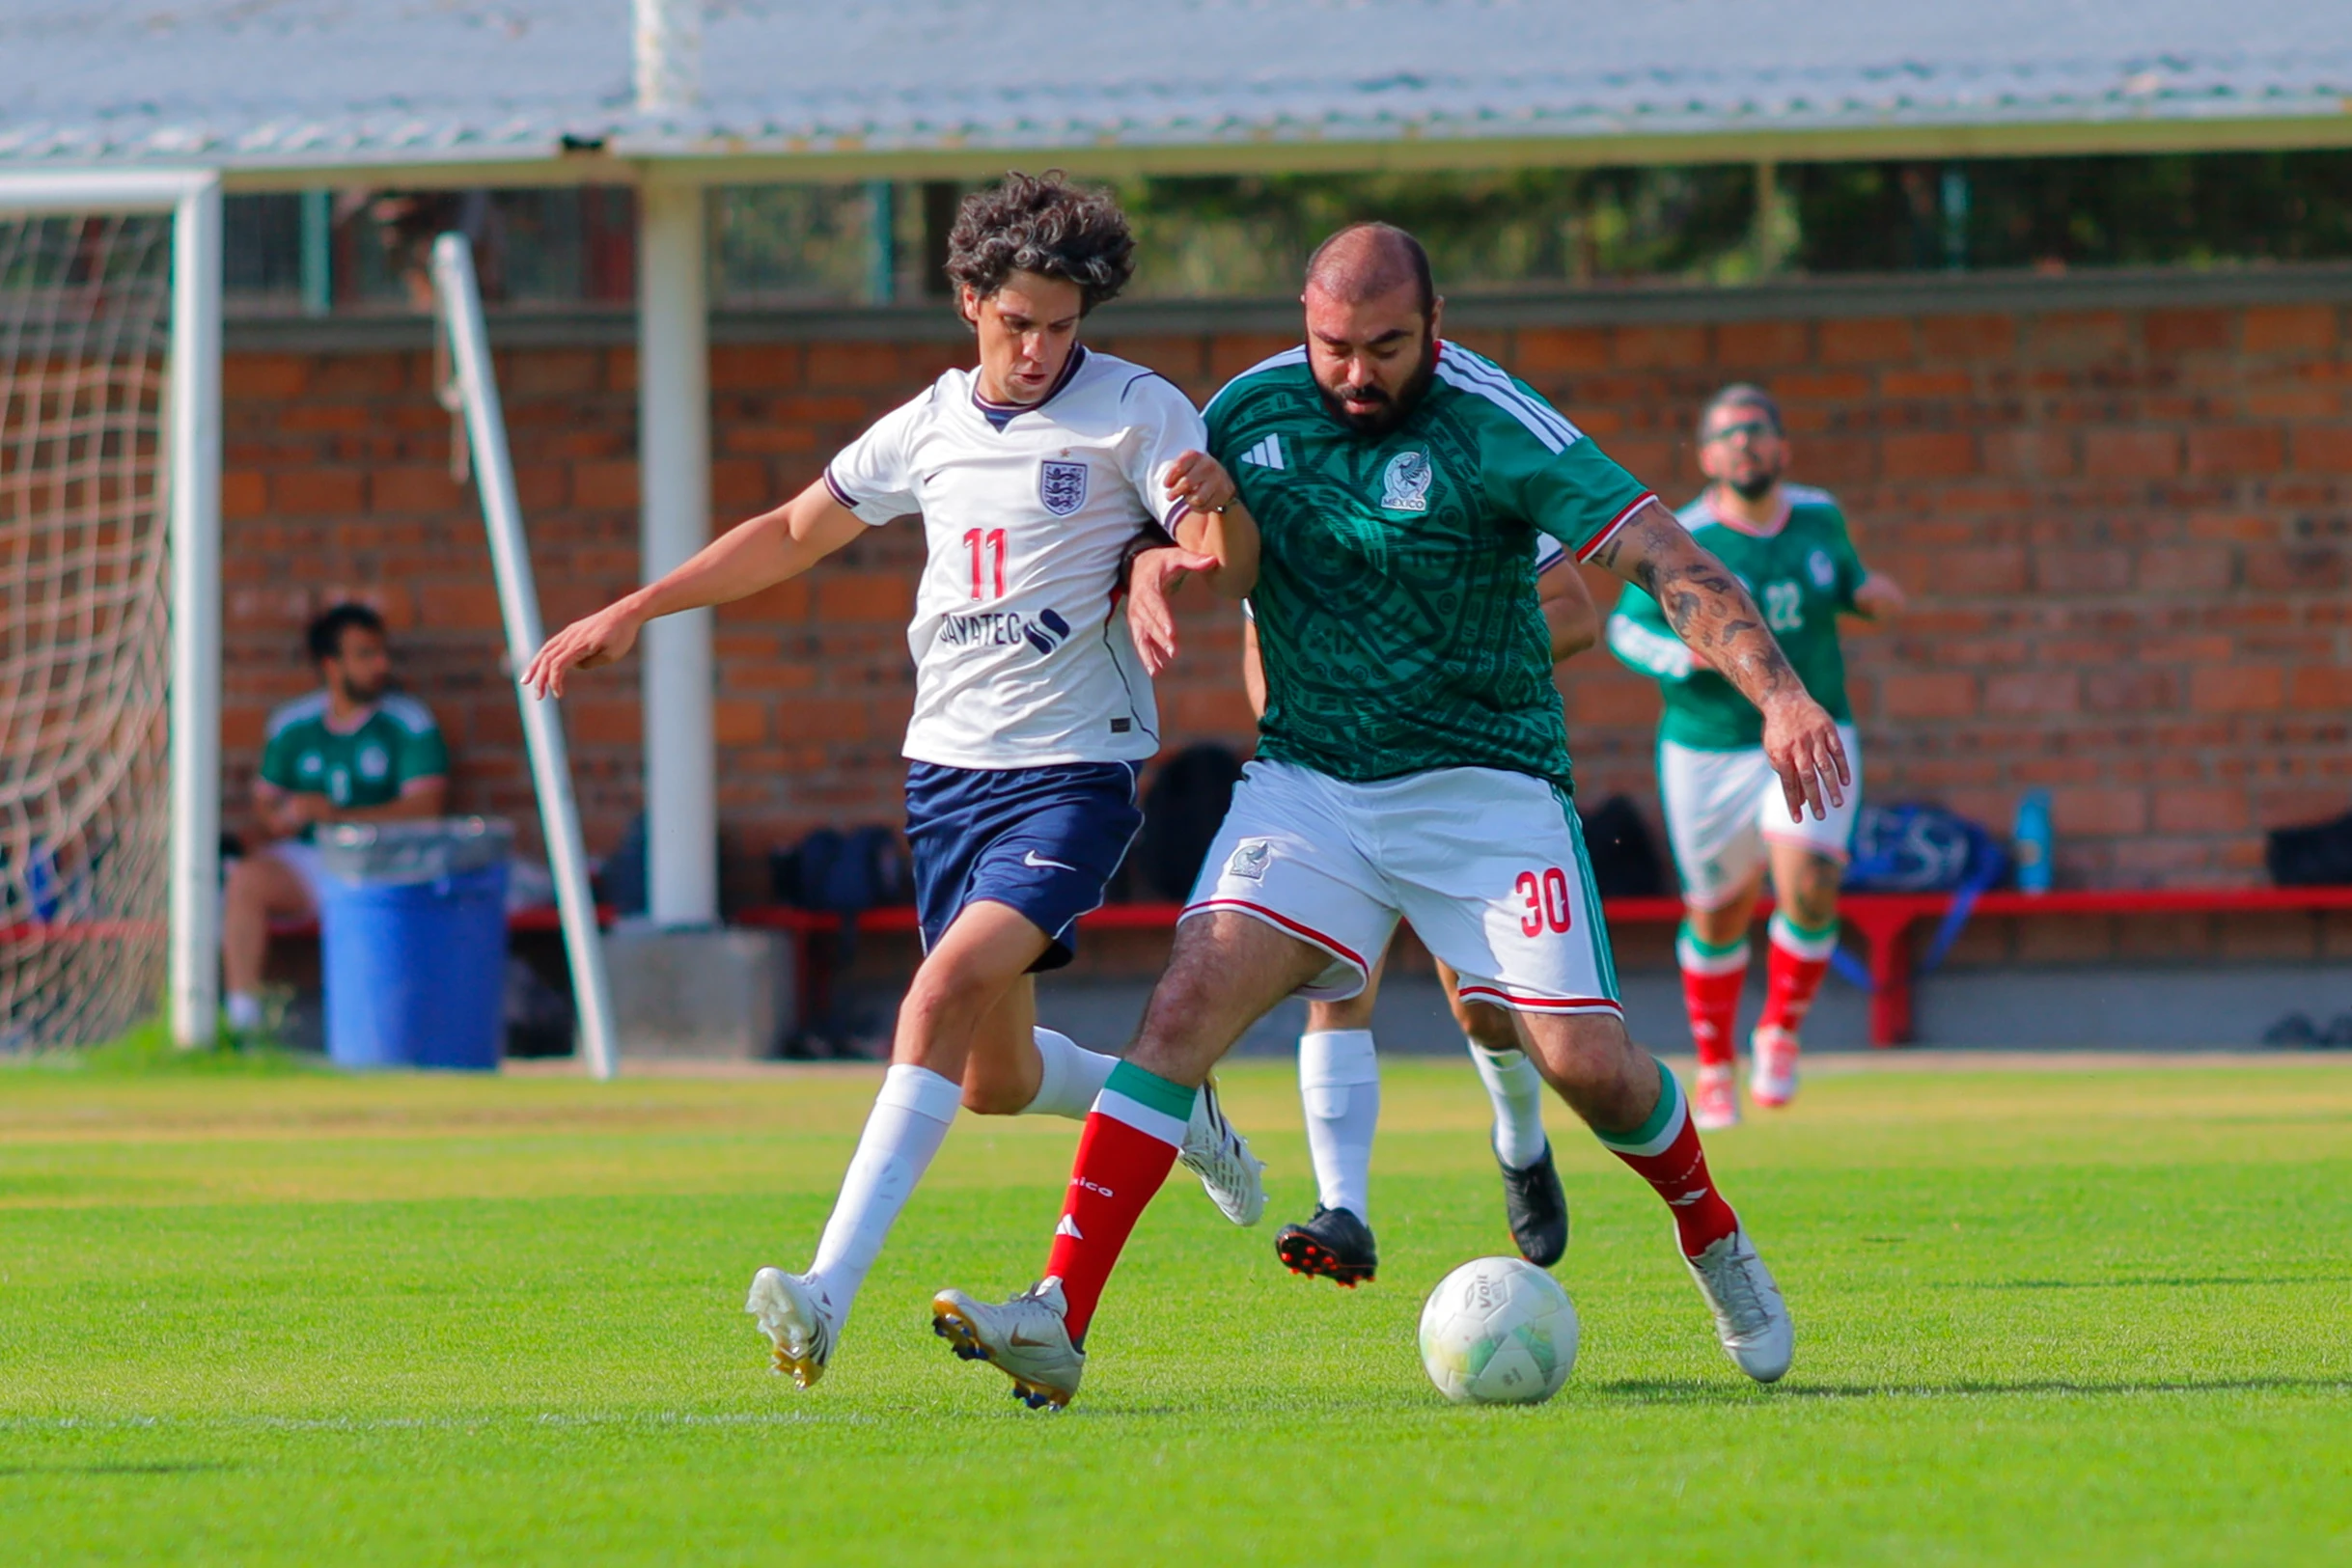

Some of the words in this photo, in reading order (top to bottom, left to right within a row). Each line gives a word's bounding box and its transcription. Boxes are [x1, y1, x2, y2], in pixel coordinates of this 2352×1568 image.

[963, 528, 1007, 601] 11
[1765, 582, 1802, 630] 22
[1515, 867, 1571, 938] 30
